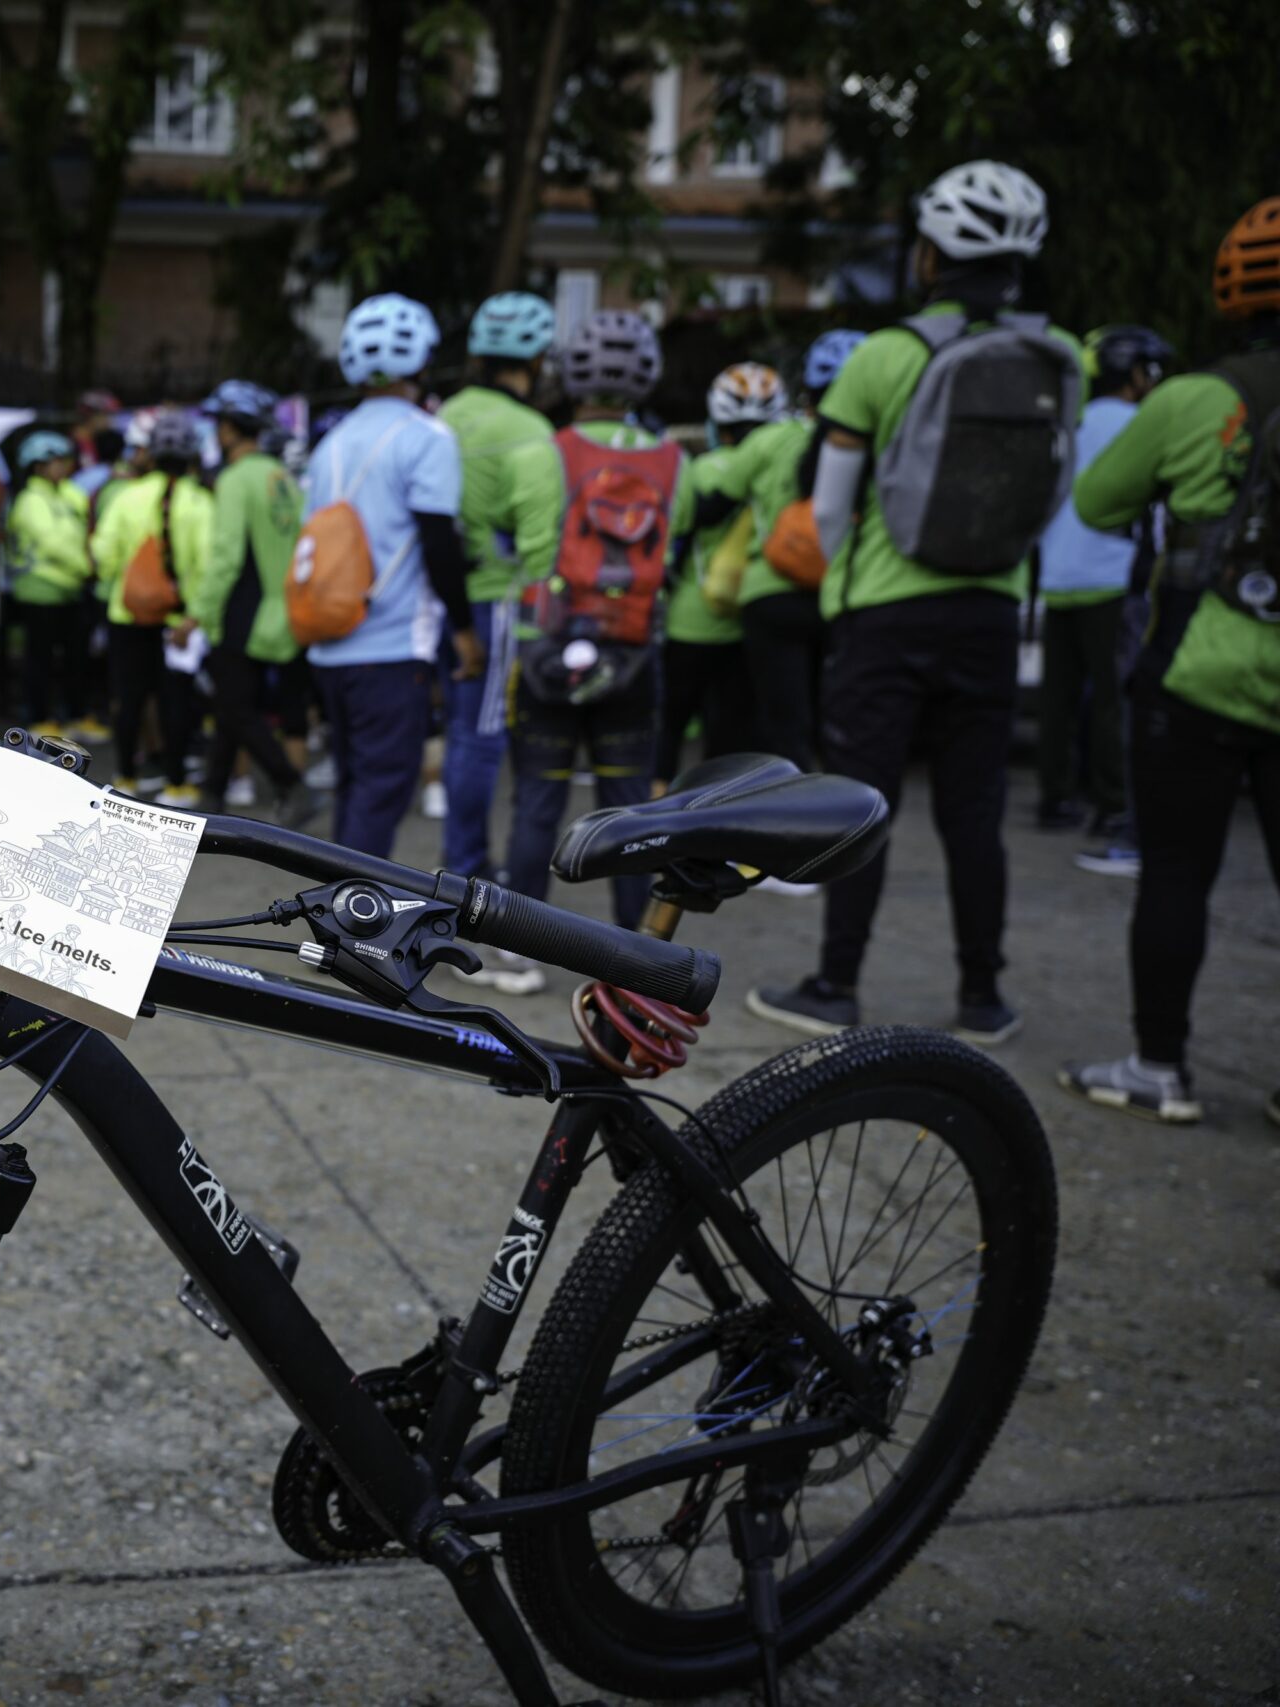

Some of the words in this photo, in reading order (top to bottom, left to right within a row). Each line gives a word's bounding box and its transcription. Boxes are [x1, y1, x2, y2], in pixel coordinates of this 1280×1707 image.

[103, 798, 145, 818] साइकल
[148, 812, 156, 821] र
[159, 814, 196, 832] सम्पदा
[12, 920, 46, 946] Ice
[50, 937, 117, 975] melts.
[354, 942, 388, 957] SHIMING
[452, 1026, 513, 1056] TRIN
